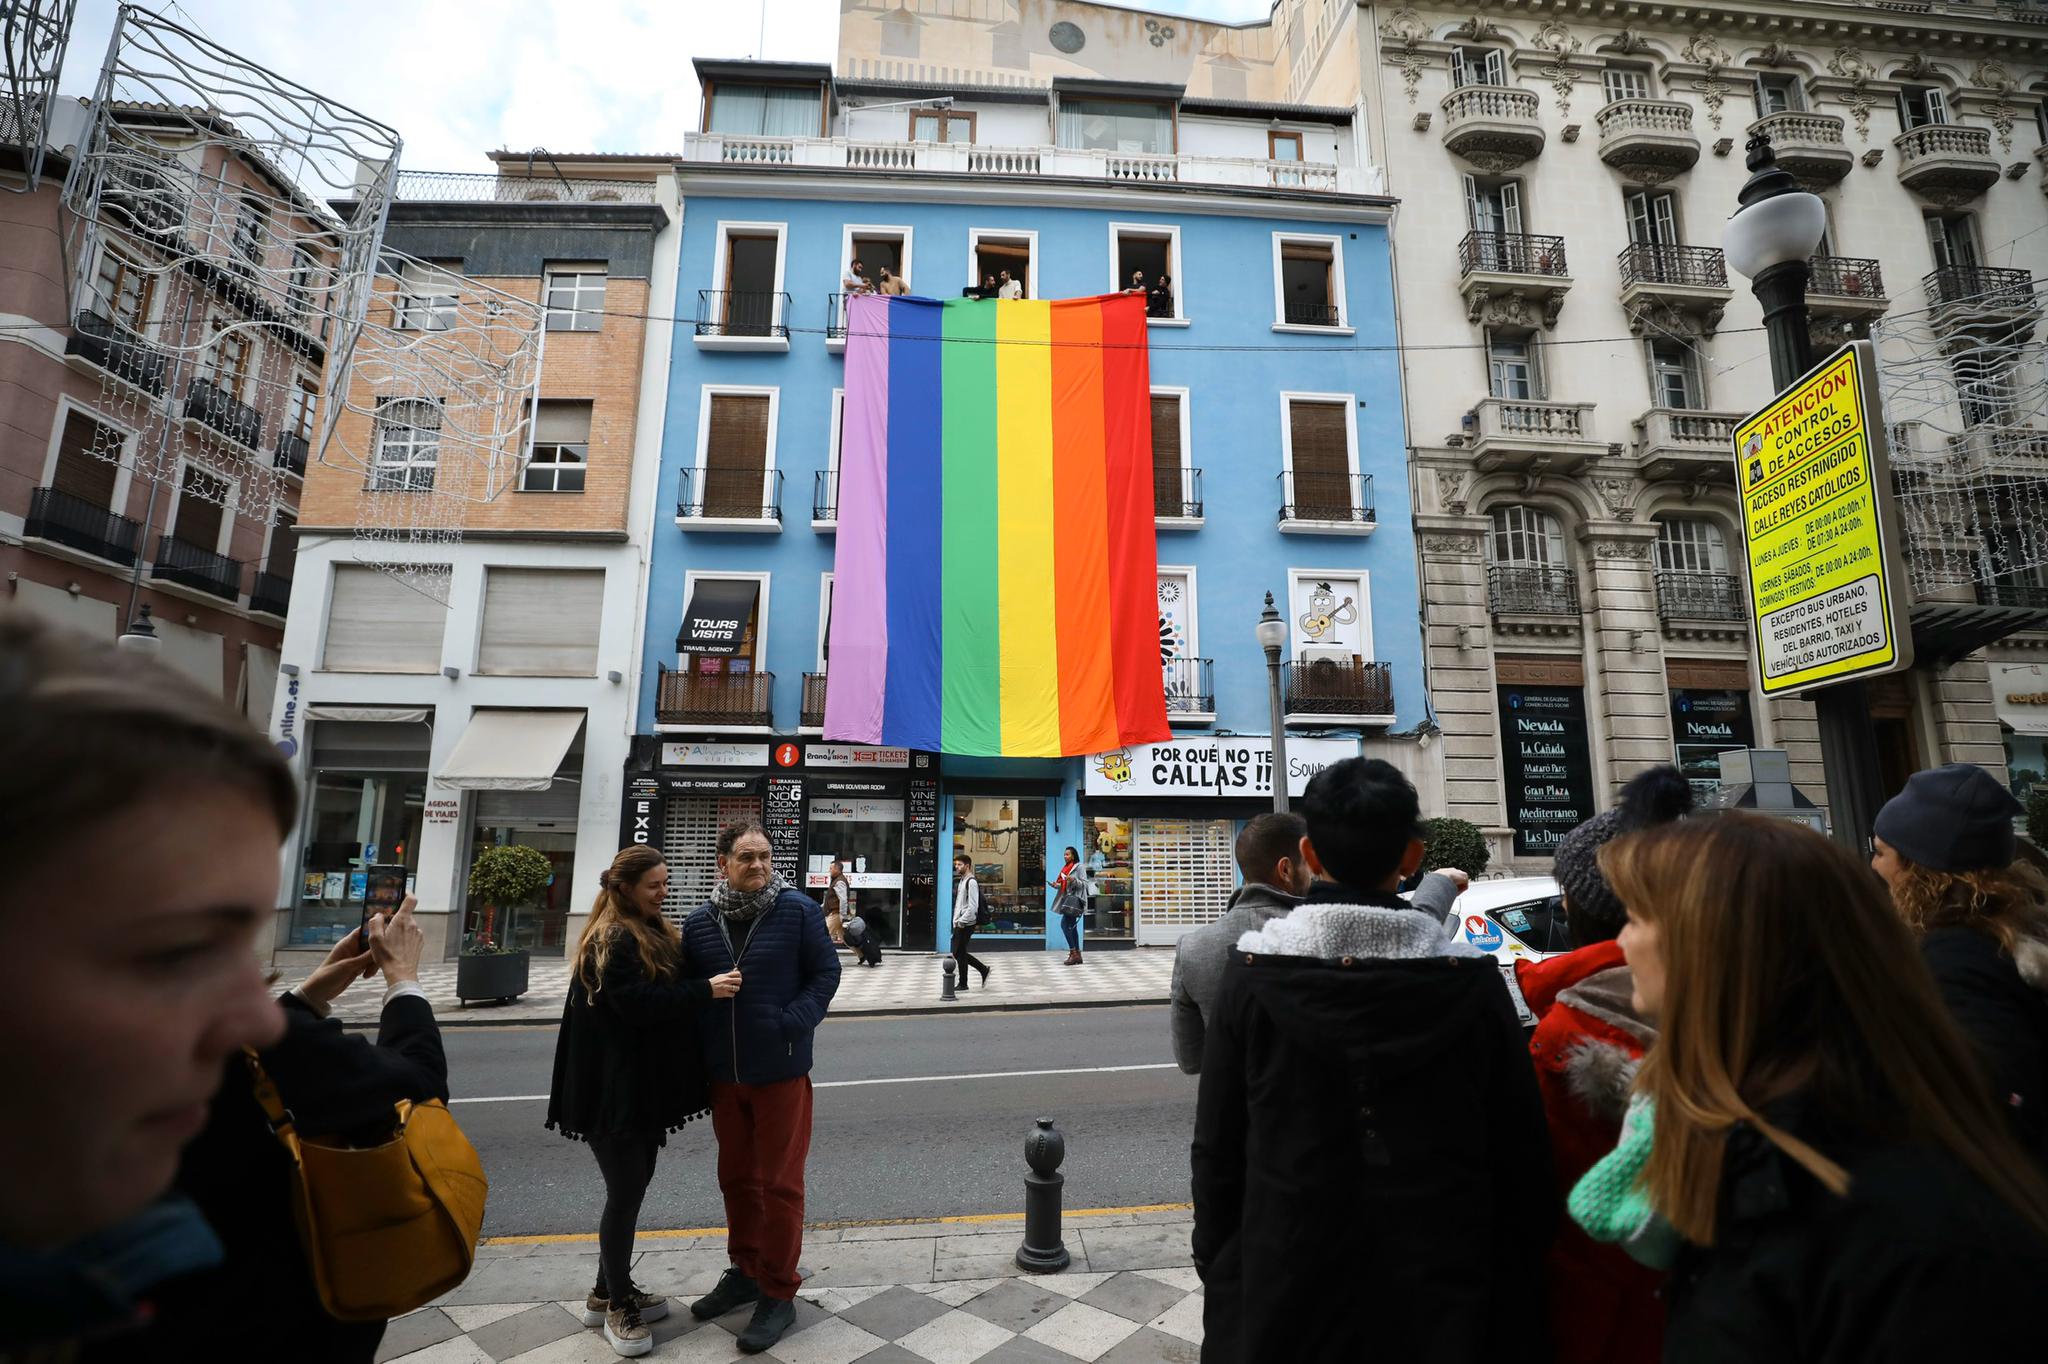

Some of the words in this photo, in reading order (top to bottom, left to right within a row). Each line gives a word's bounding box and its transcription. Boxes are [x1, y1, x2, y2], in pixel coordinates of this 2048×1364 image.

[1763, 369, 1847, 440] ATENCIÓN
[1775, 403, 1838, 450] CONTROL
[1768, 455, 1784, 473] DE
[1787, 413, 1851, 463] ACCESOS
[1752, 483, 1786, 512] ACCESO
[1788, 441, 1857, 492] RESTRINGIDO
[1754, 511, 1777, 534] CALLE
[1780, 495, 1807, 520] REYES
[1808, 466, 1860, 506] CATÓLICOS
[1805, 520, 1815, 534] DE
[1815, 514, 1832, 530] 00:00
[1832, 511, 1837, 521] A
[1861, 495, 1867, 507] Y
[1807, 538, 1816, 550] DE
[1817, 530, 1833, 546] 07:30
[1834, 527, 1839, 538] A
[1755, 551, 1772, 567] LUNES
[1772, 549, 1777, 559] A
[1815, 565, 1825, 578] DE
[1825, 557, 1842, 573] 00:00
[1843, 555, 1848, 566] A
[1759, 575, 1781, 593] VIERNES
[1759, 589, 1785, 608] DOMINGOS
[1785, 586, 1790, 597] Y
[1770, 607, 1806, 627] EXCEPTO
[1807, 599, 1825, 614] BUS
[1826, 585, 1868, 608] URBANO,
[691, 629, 734, 639] VISITS
[693, 618, 739, 629] TOURS
[1774, 618, 1825, 641] RESIDENTES,
[1826, 601, 1868, 625] HOTELES
[1783, 641, 1798, 653] DEL
[1799, 630, 1834, 649] BARRIO,
[1834, 624, 1855, 638] TAXI
[1856, 620, 1862, 631] Y
[1816, 632, 1880, 659] AUTORIZADOS
[1152, 748, 1182, 763] POR
[1185, 744, 1217, 764] QUÉ
[1225, 749, 1250, 763] NO
[1255, 751, 1273, 763] TE
[1152, 764, 1248, 787] CALLAS
[425, 810, 433, 818] DE
[633, 801, 650, 843] EXC
